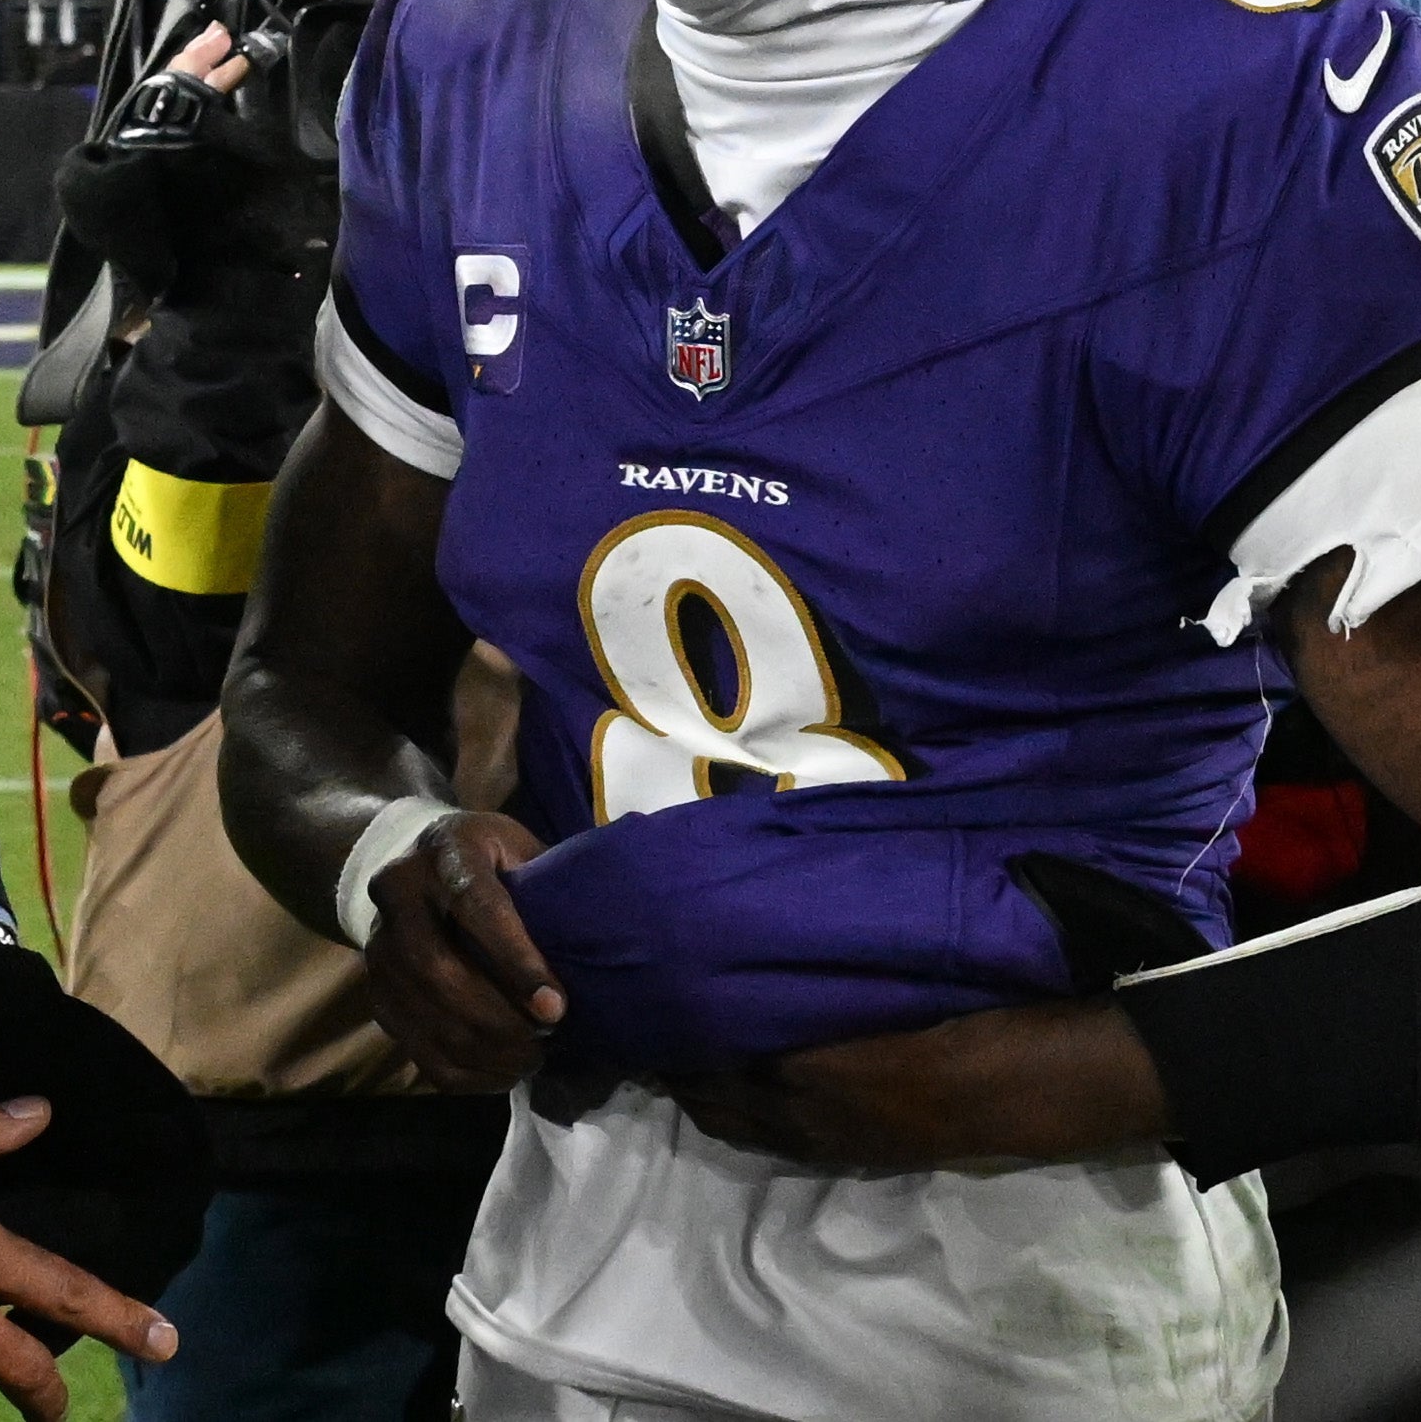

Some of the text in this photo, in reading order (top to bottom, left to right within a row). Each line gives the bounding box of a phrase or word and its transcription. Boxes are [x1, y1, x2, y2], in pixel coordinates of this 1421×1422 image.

[455, 254, 520, 355] C
[677, 346, 722, 383] NFL
[618, 464, 790, 506] RAVENS
[578, 509, 907, 827] 8
